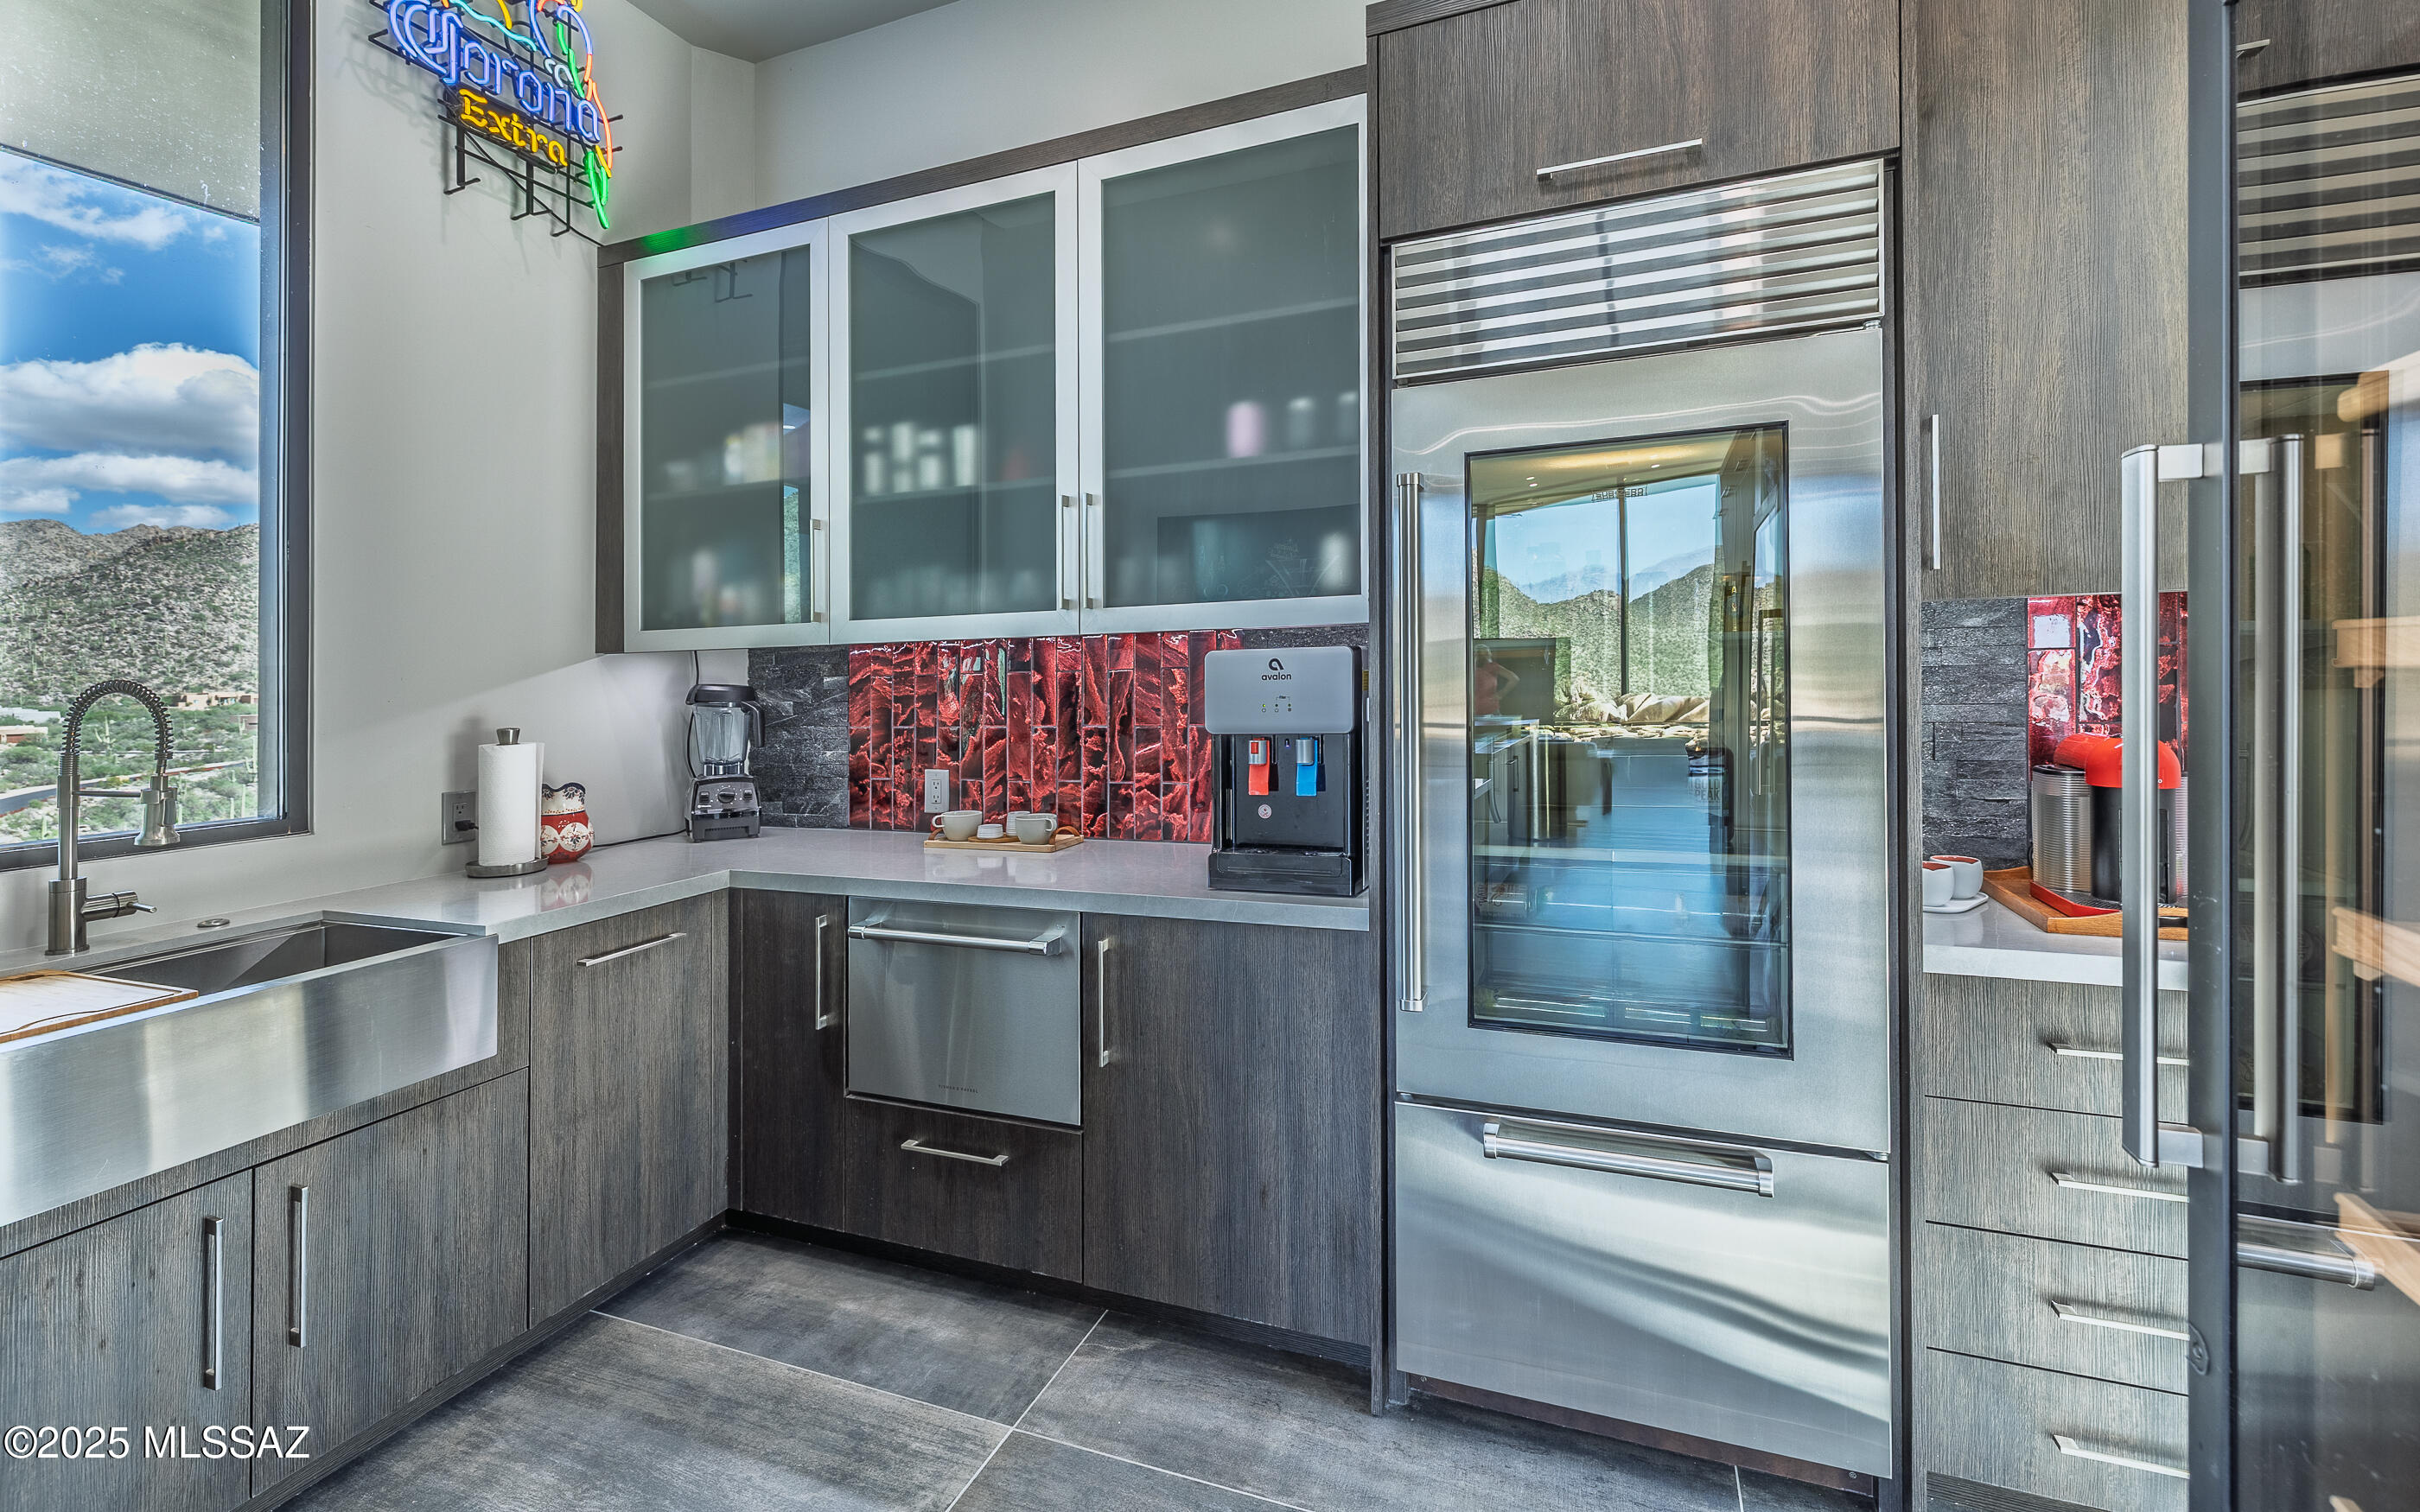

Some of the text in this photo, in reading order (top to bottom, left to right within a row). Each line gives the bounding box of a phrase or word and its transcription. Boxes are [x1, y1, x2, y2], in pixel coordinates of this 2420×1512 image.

[389, 0, 602, 143] Corona
[459, 88, 569, 167] Extra
[1261, 671, 1292, 681] avalon
